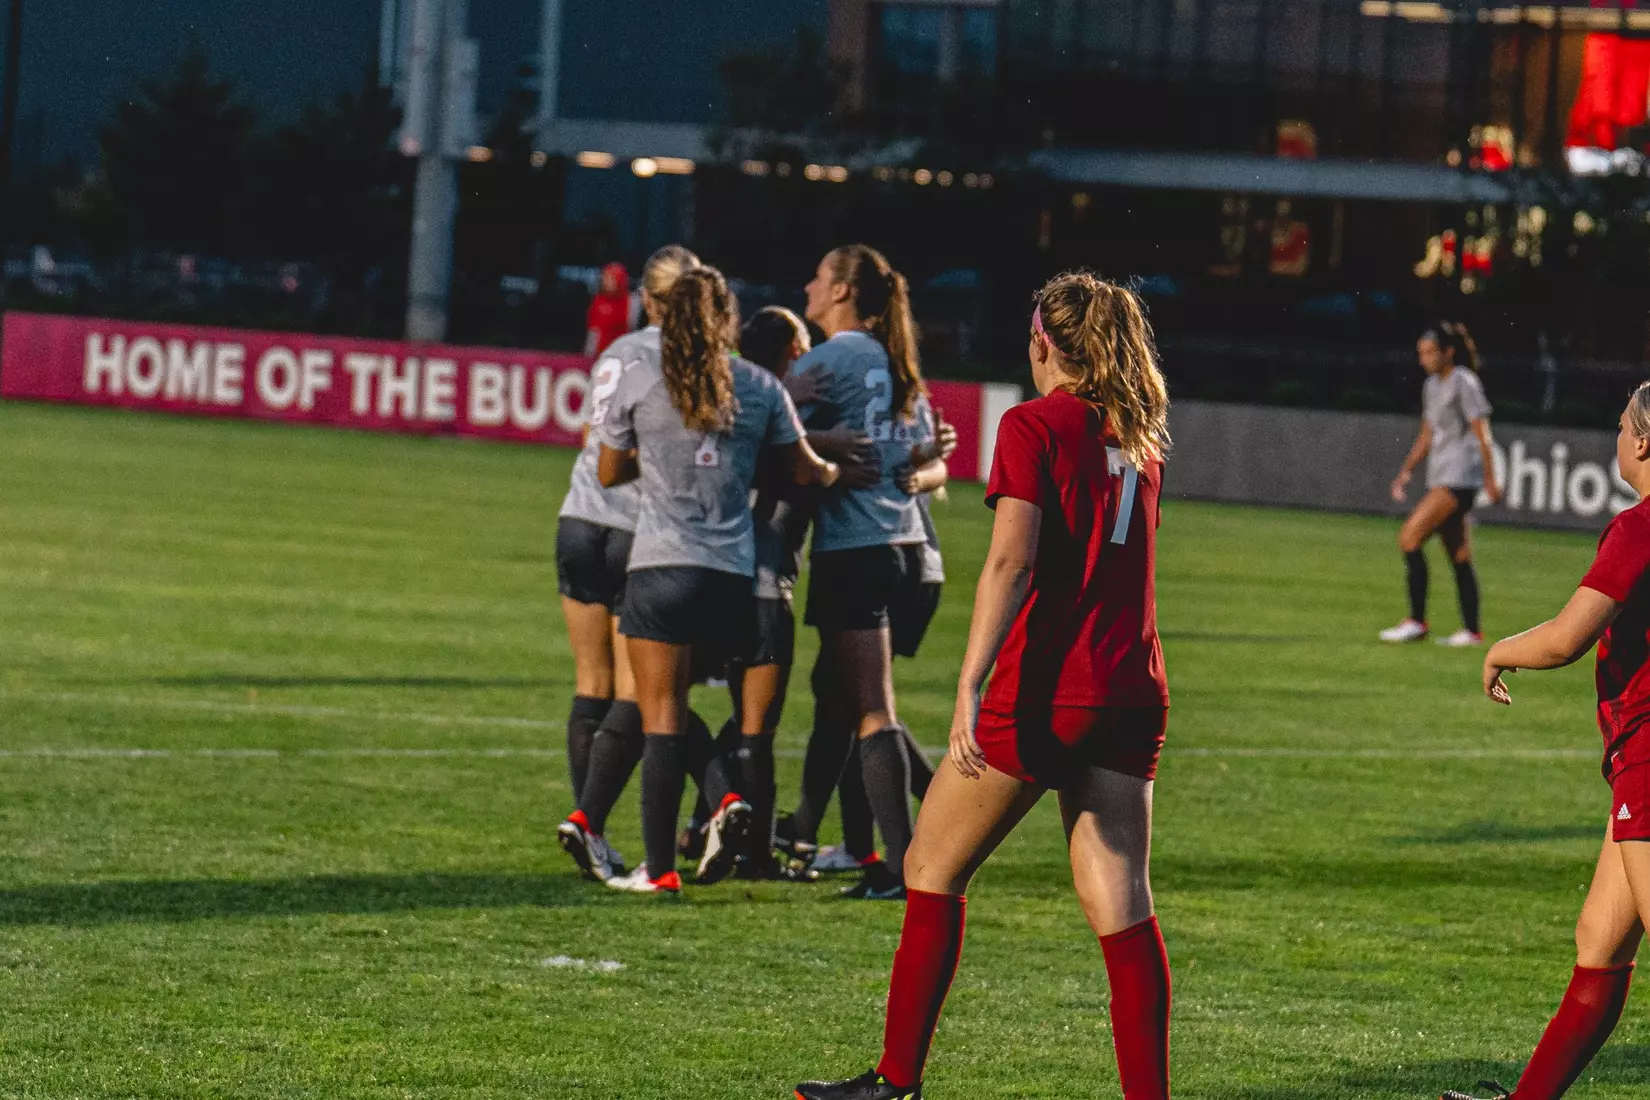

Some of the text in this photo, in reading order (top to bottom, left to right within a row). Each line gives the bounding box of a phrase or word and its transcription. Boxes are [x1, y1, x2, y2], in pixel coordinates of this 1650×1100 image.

[85, 333, 246, 404] HOME
[257, 347, 334, 409] OF
[344, 353, 457, 421] THE
